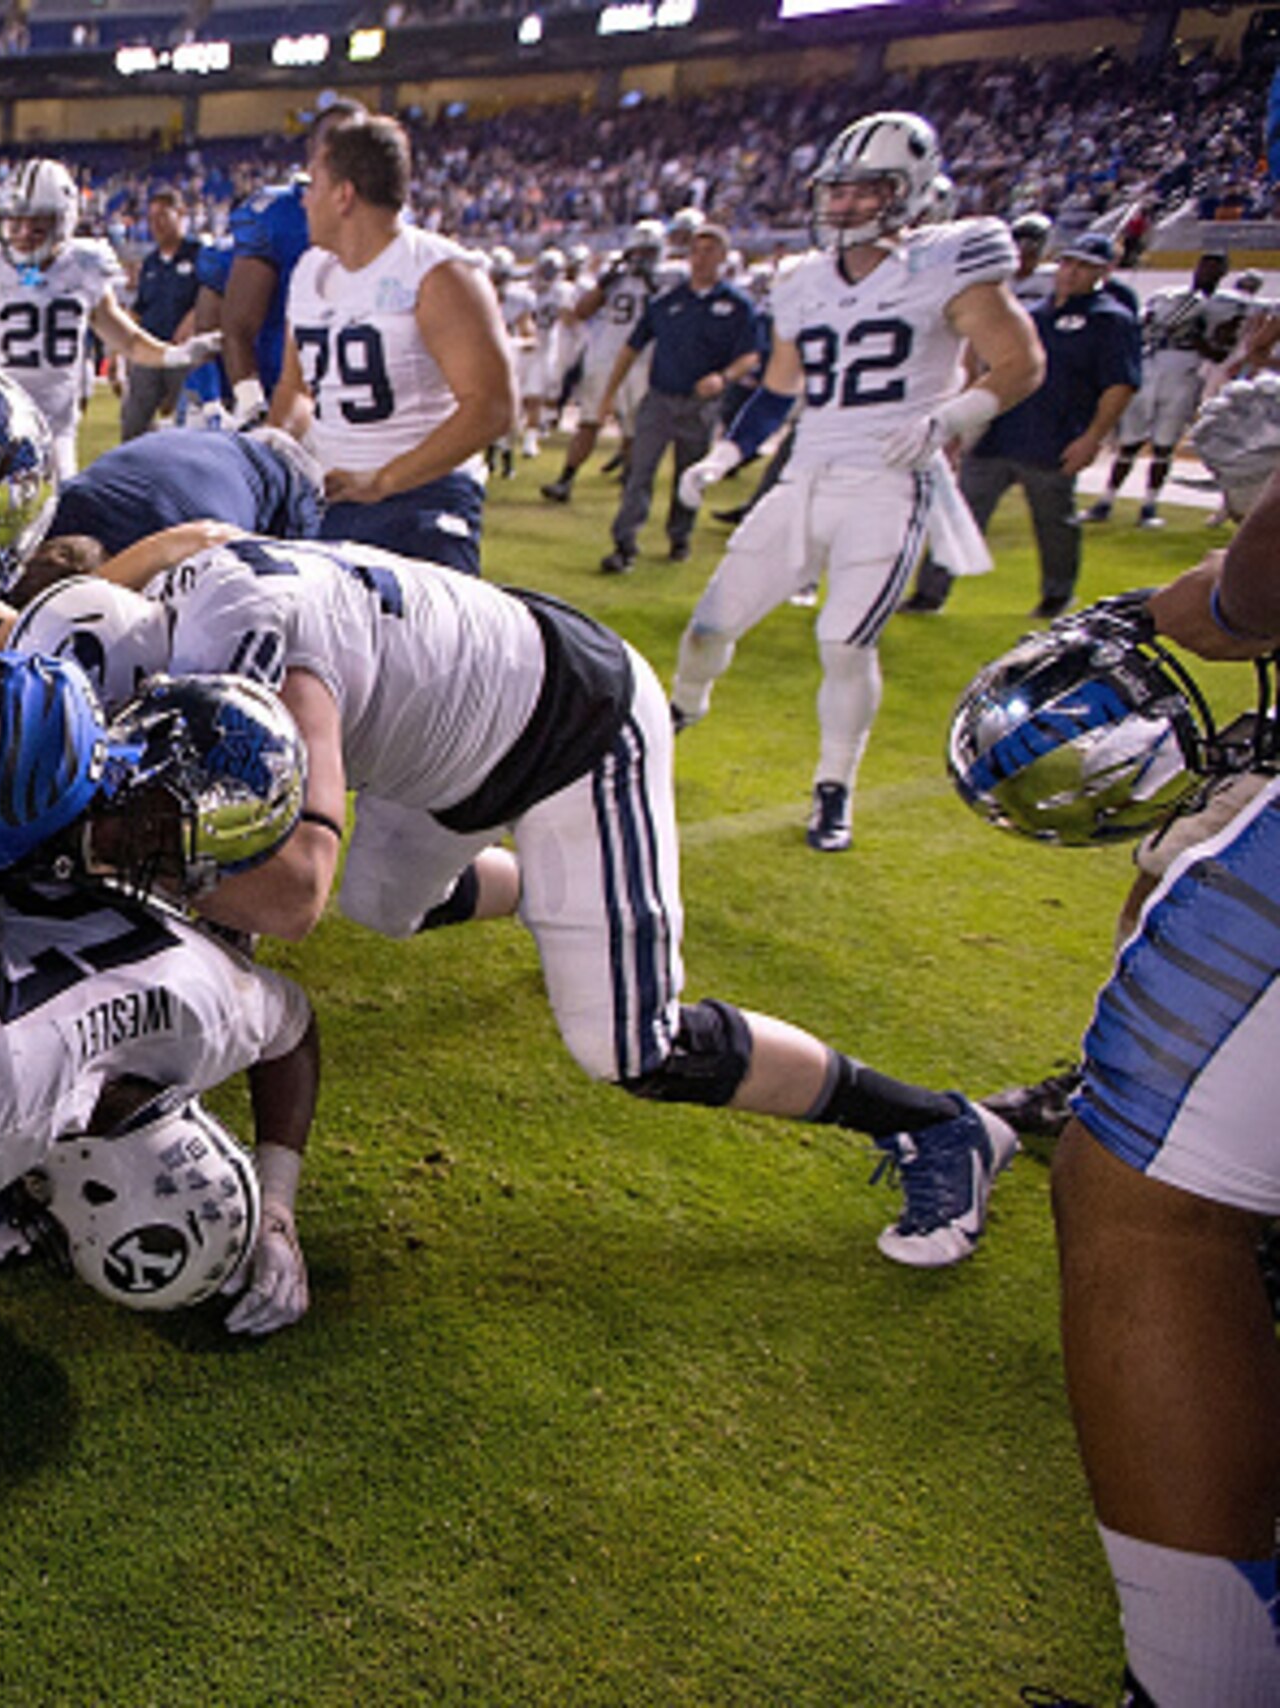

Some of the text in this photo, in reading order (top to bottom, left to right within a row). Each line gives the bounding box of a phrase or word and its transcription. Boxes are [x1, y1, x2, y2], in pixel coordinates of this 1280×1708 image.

[0, 298, 83, 368] 26
[294, 323, 394, 425] 79
[795, 317, 914, 408] 82
